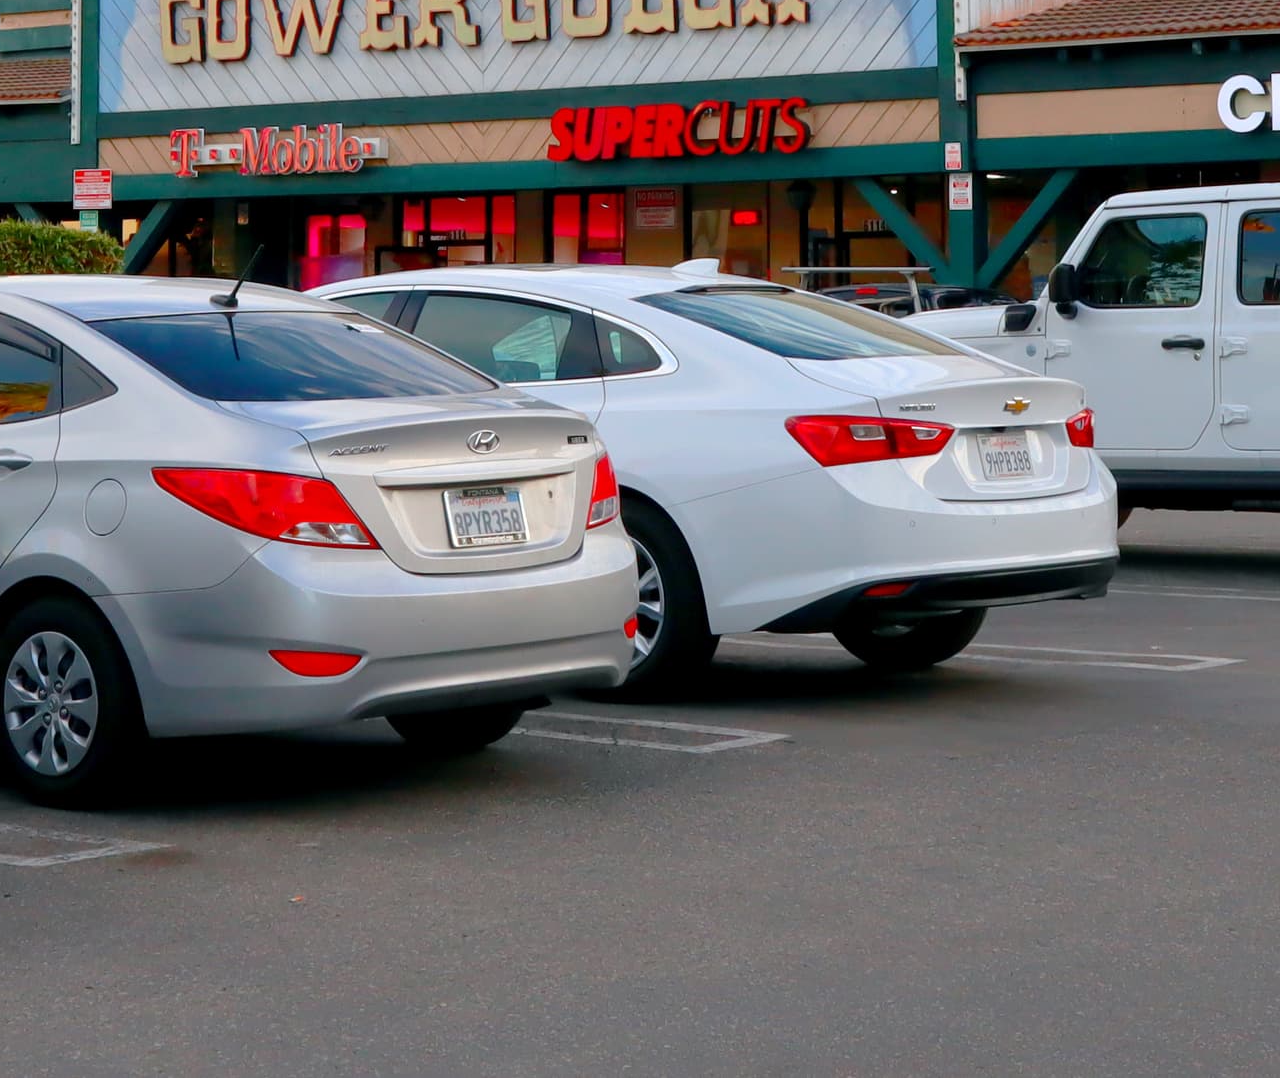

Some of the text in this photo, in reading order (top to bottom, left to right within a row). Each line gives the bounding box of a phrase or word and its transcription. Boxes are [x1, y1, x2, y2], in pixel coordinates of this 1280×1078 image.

[547, 96, 811, 162] SUPERCUTS
[328, 443, 389, 457] ACCENT
[455, 509, 522, 536] 8PYR358
